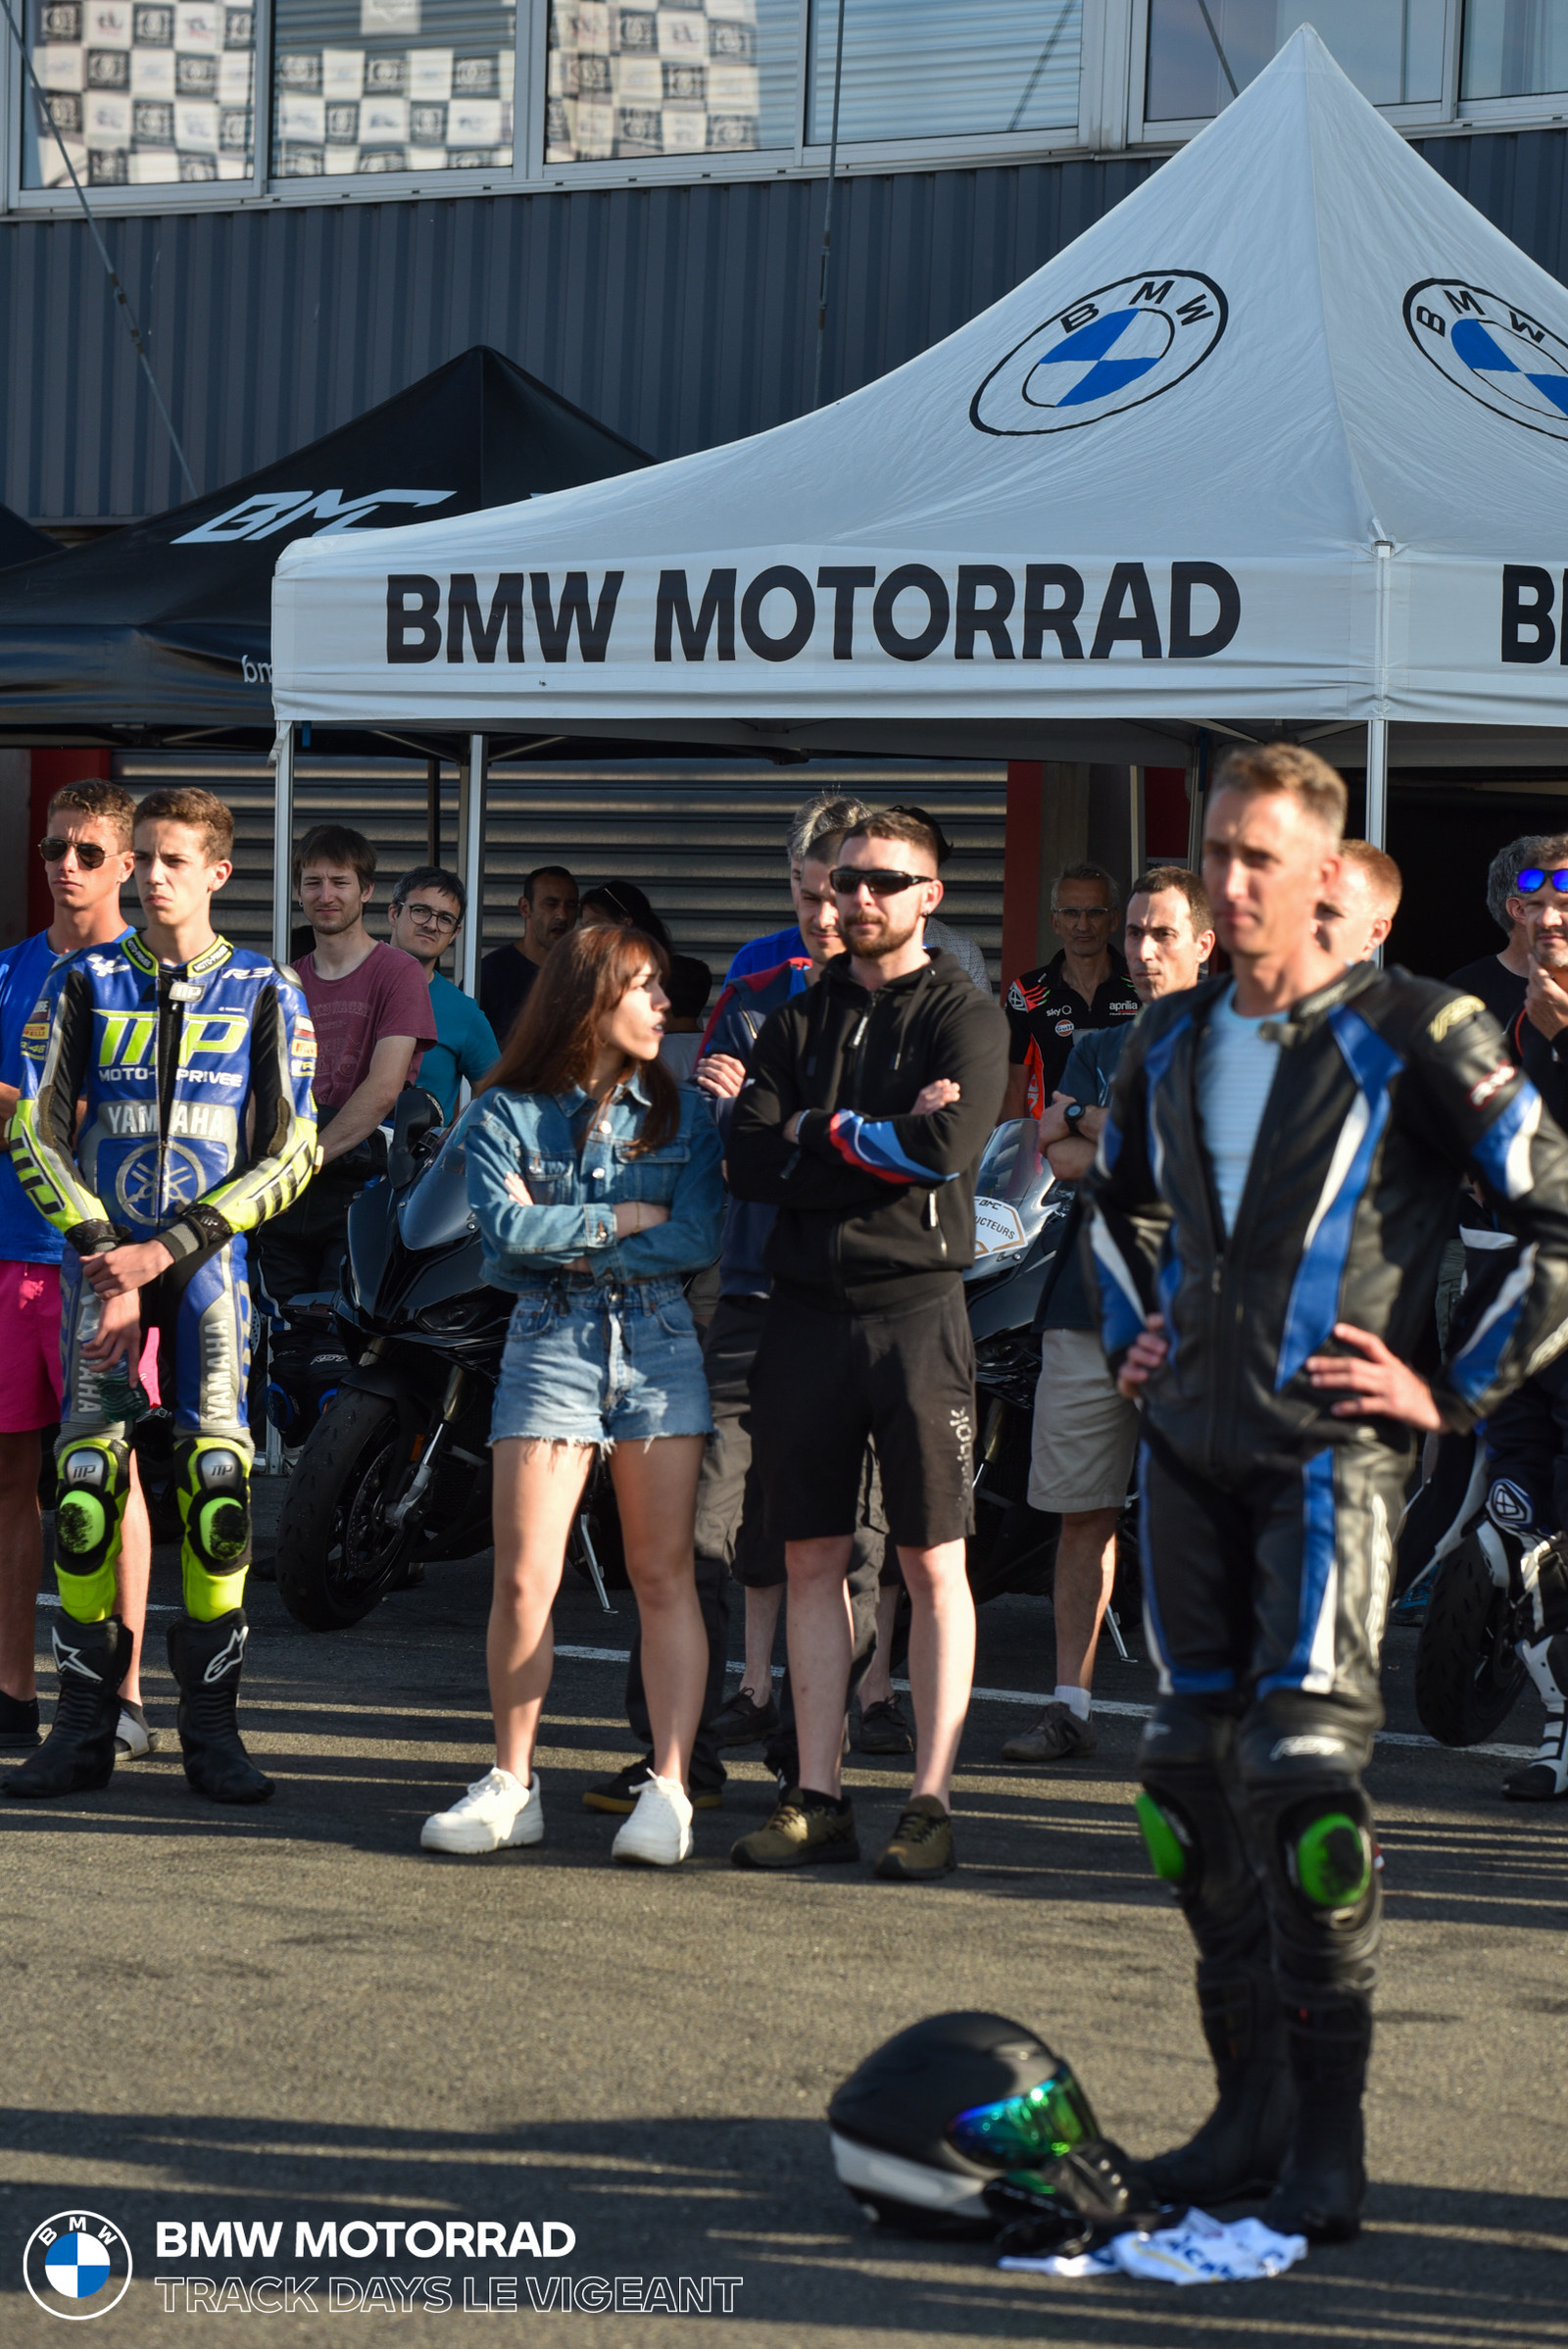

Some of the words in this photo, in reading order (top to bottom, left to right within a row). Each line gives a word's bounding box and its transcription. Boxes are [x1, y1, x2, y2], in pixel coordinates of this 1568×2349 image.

[1060, 280, 1214, 333] BMW
[1416, 290, 1545, 343] BMW
[387, 570, 624, 663] BMW
[654, 561, 1242, 662] MOTORRAD
[1109, 1000, 1138, 1012] aprilia
[107, 1104, 223, 1137] YAMAHA
[204, 1320, 232, 1421] YAMAHA
